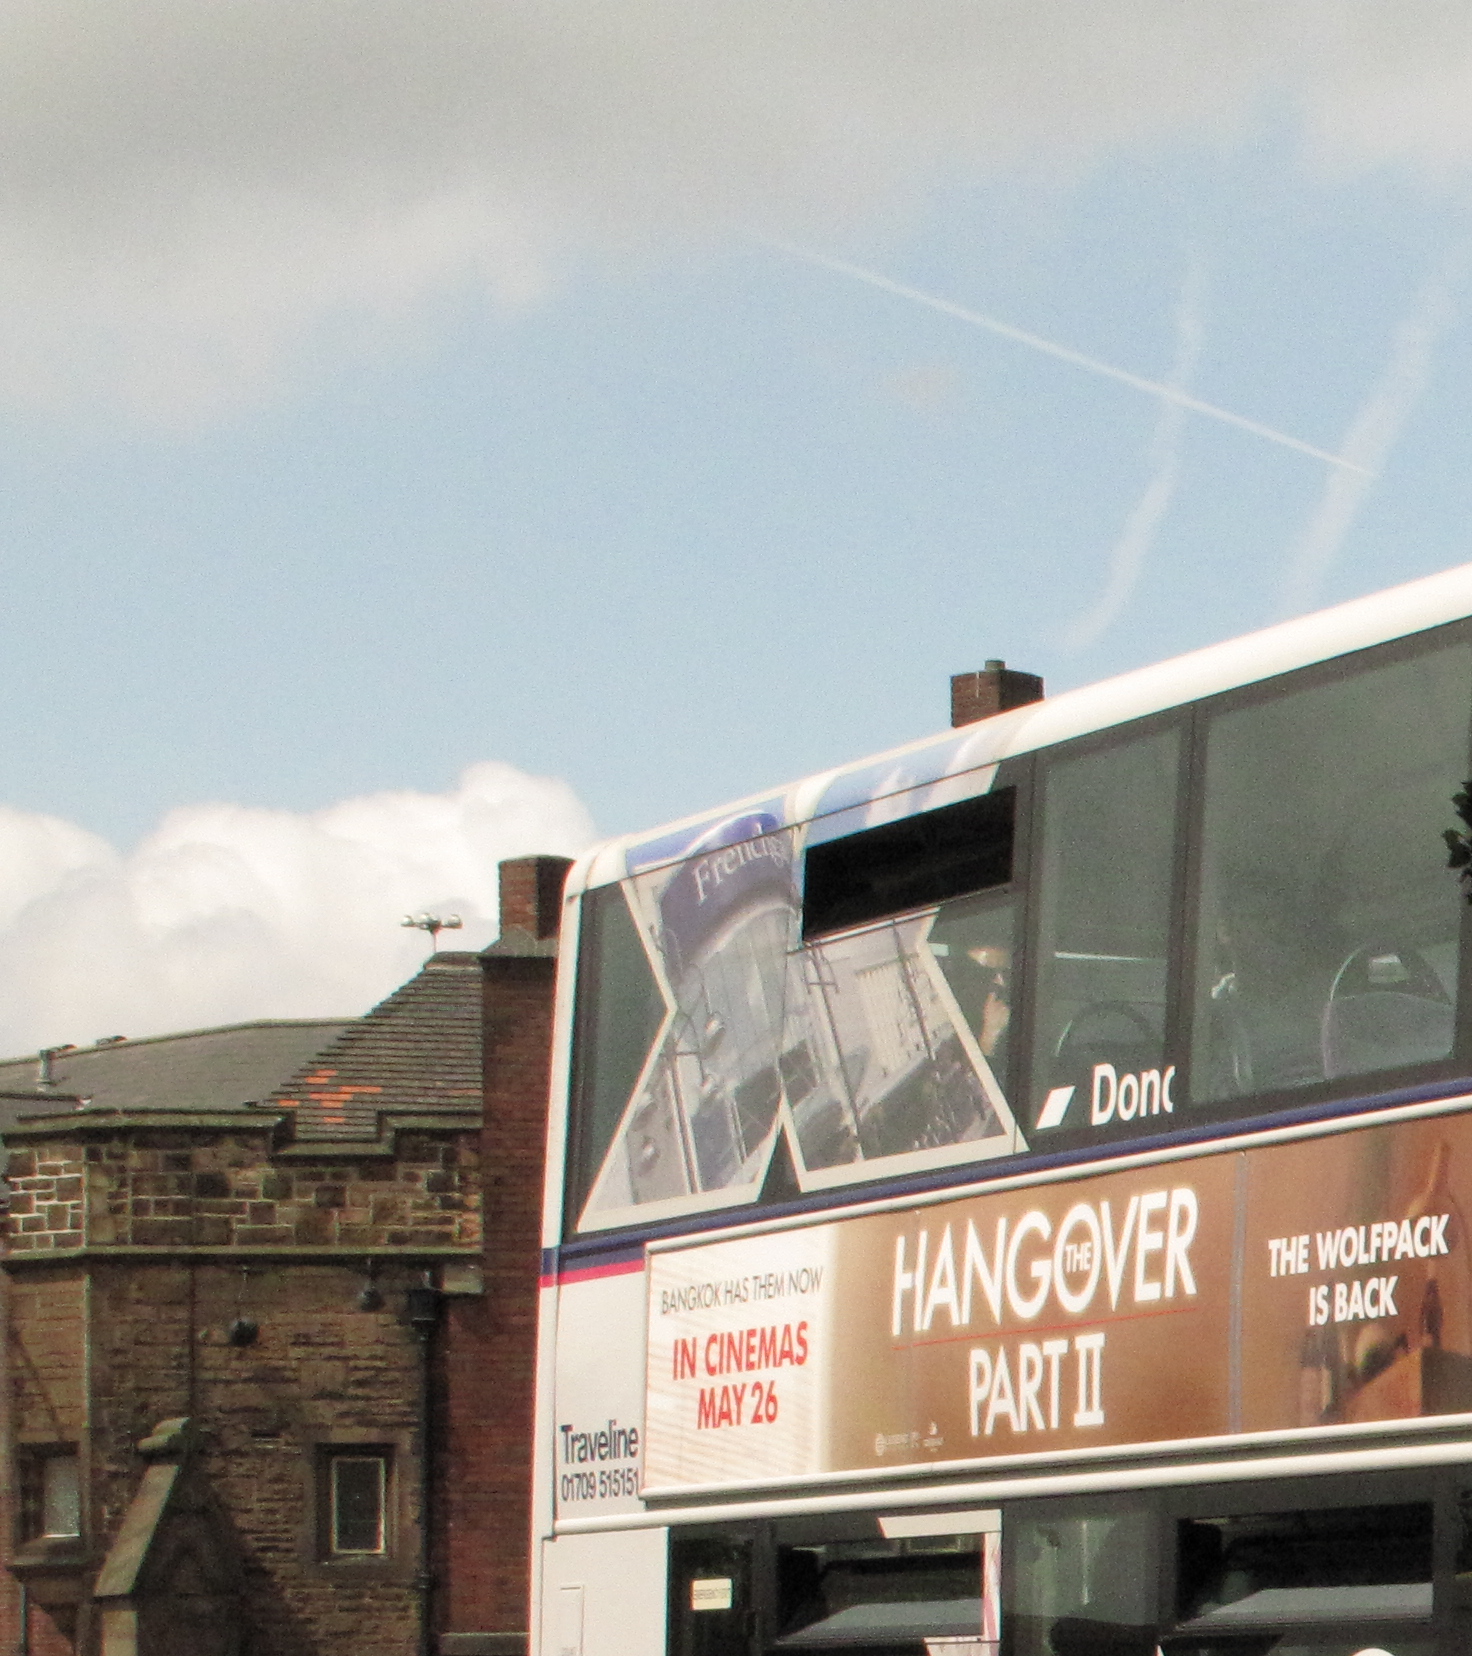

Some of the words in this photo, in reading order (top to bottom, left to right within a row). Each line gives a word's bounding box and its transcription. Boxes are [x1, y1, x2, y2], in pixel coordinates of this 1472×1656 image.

[890, 1188, 1198, 1336] HANGOVER
[1064, 1239, 1094, 1273] THE
[1267, 1235, 1310, 1277] THE
[1314, 1214, 1449, 1270] WOLFPACK
[660, 1280, 724, 1318] BANGKOK
[724, 1276, 750, 1307] HAS
[752, 1271, 785, 1303] THEM
[786, 1264, 823, 1300] NOW
[1308, 1287, 1330, 1326] IS
[1333, 1274, 1398, 1322] BACK
[671, 1338, 698, 1382] IN
[703, 1320, 809, 1378] CINEMAS
[696, 1386, 746, 1430] MAY
[749, 1380, 780, 1424] 26
[968, 1338, 1068, 1440] PART
[561, 1420, 639, 1465] Traveline
[561, 1472, 597, 1502] 01709
